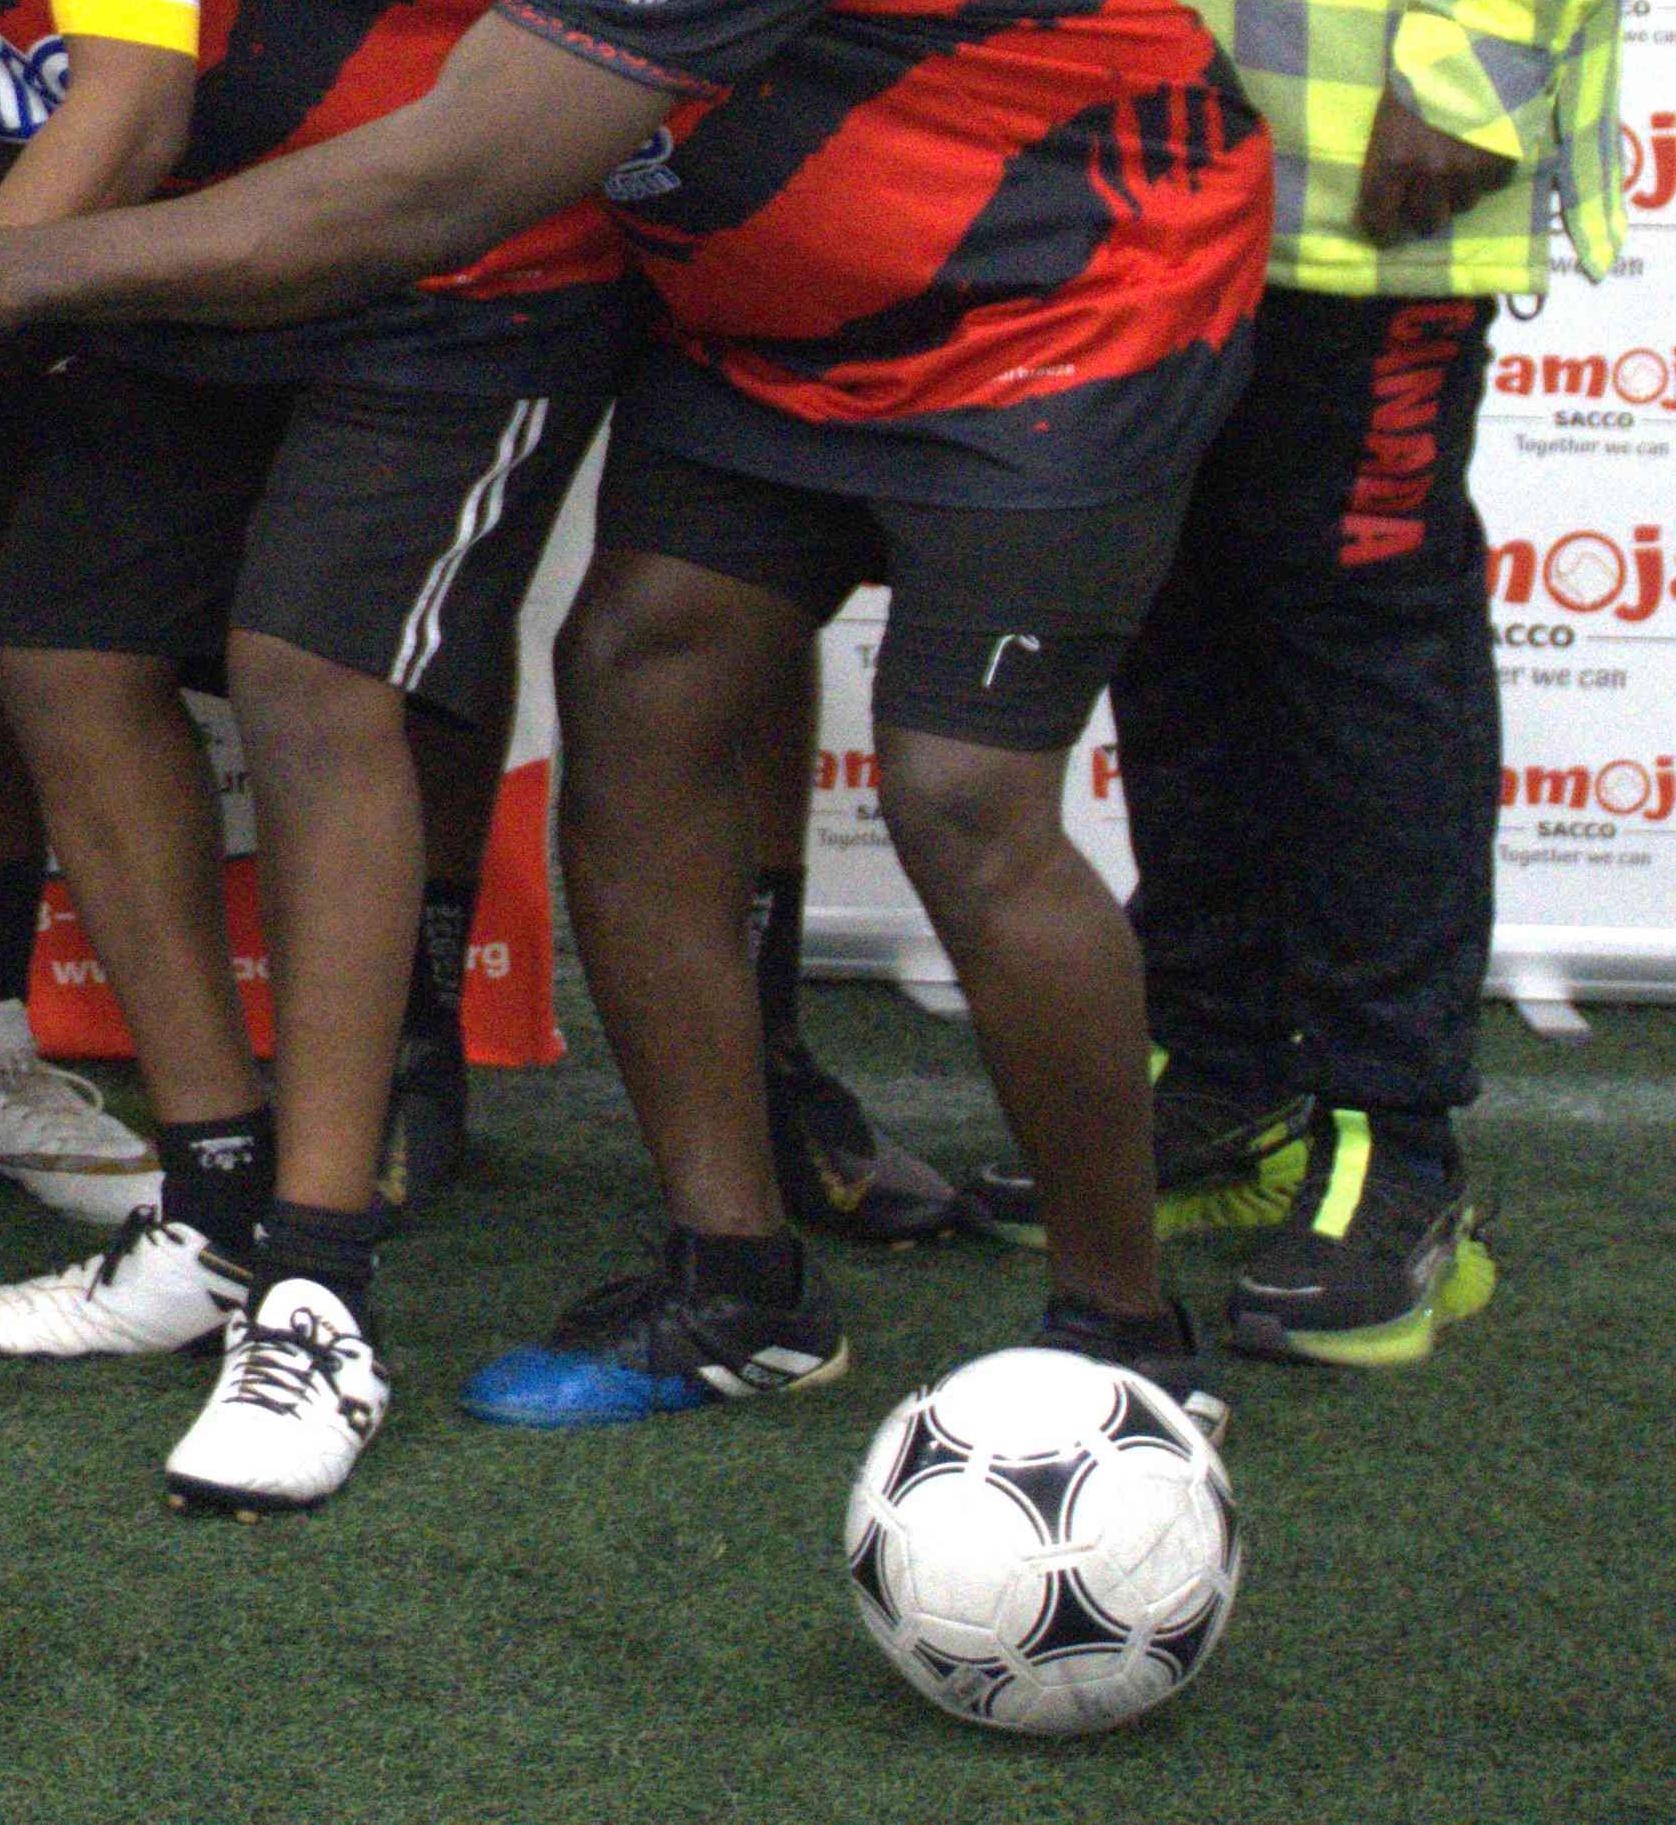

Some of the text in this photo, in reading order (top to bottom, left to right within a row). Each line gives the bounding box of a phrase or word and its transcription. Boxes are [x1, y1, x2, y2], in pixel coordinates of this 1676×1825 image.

[1553, 410, 1635, 430] SACCO
[1337, 300, 1478, 567] CANADA
[1536, 821, 1617, 840] SACCO
